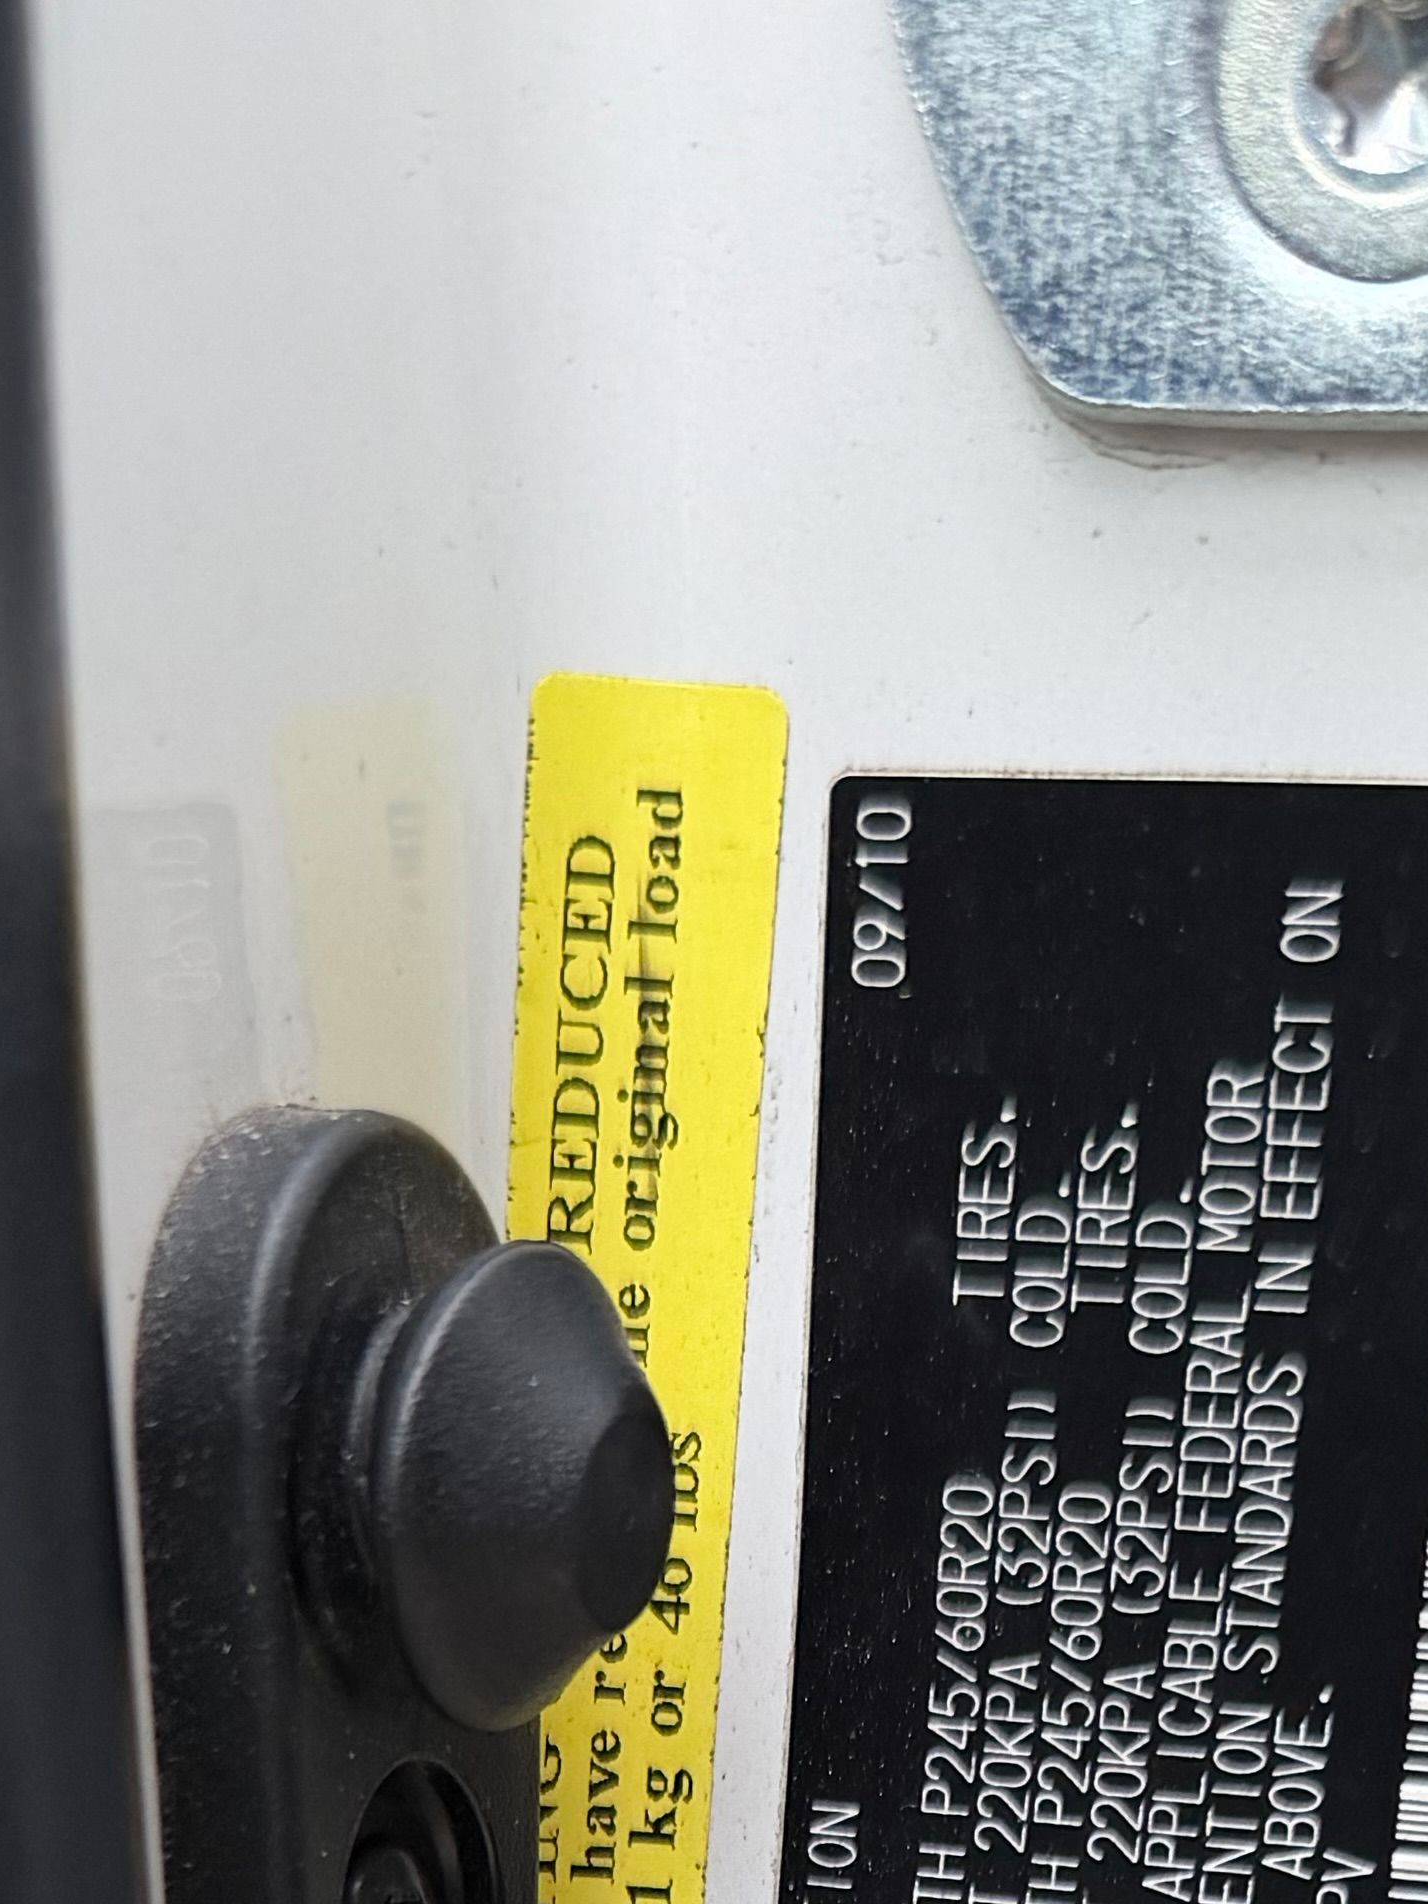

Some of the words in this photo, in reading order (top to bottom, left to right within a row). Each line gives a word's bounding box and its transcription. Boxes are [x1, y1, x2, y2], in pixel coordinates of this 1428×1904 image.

[626, 786, 686, 940] load
[850, 802, 912, 986] 09/10
[1280, 879, 1345, 964] ON
[545, 831, 618, 1253] REDUCED
[609, 973, 688, 1253] original
[1260, 992, 1334, 1220] EFFECT
[952, 1095, 1018, 1306] TIRES.
[1196, 1062, 1265, 1253] MOTOR
[1253, 1242, 1313, 1316] IN
[1174, 1281, 1250, 1532] FEDERAL
[1222, 1350, 1304, 1673] STANDARDS
[647, 1668, 688, 1736] or
[920, 1476, 995, 1816] P245/60R20
[1141, 1560, 1226, 1901] APPLICABLE
[570, 1728, 624, 1879] have
[626, 1765, 694, 1850] kg
[1260, 1682, 1333, 1879] ABOVE.
